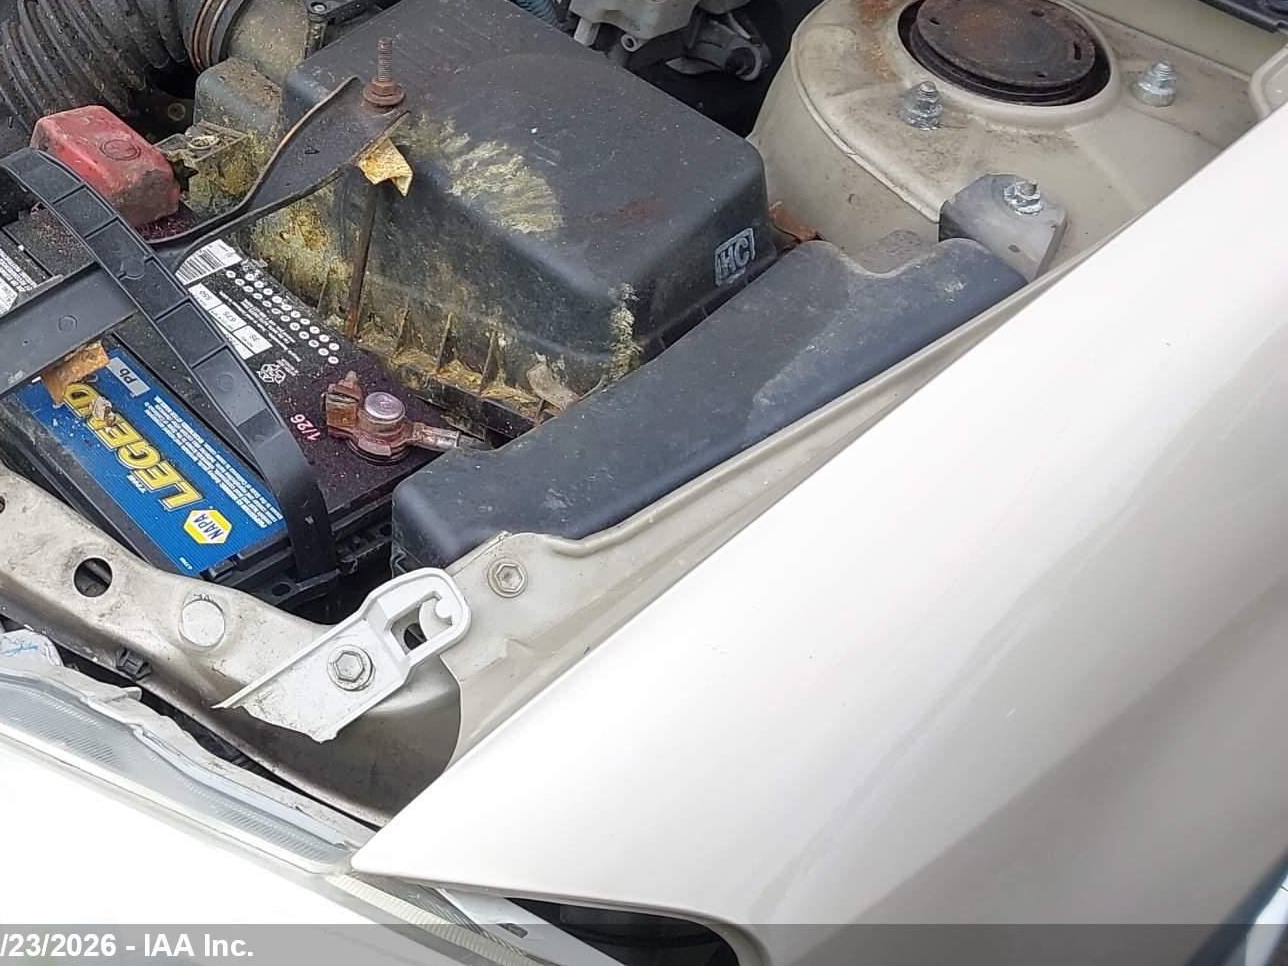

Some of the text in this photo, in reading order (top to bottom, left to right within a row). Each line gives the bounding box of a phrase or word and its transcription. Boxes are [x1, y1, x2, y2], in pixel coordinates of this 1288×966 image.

[120, 368, 137, 384] Pb
[289, 411, 322, 442] 1/26
[193, 512, 225, 541] NAPA
